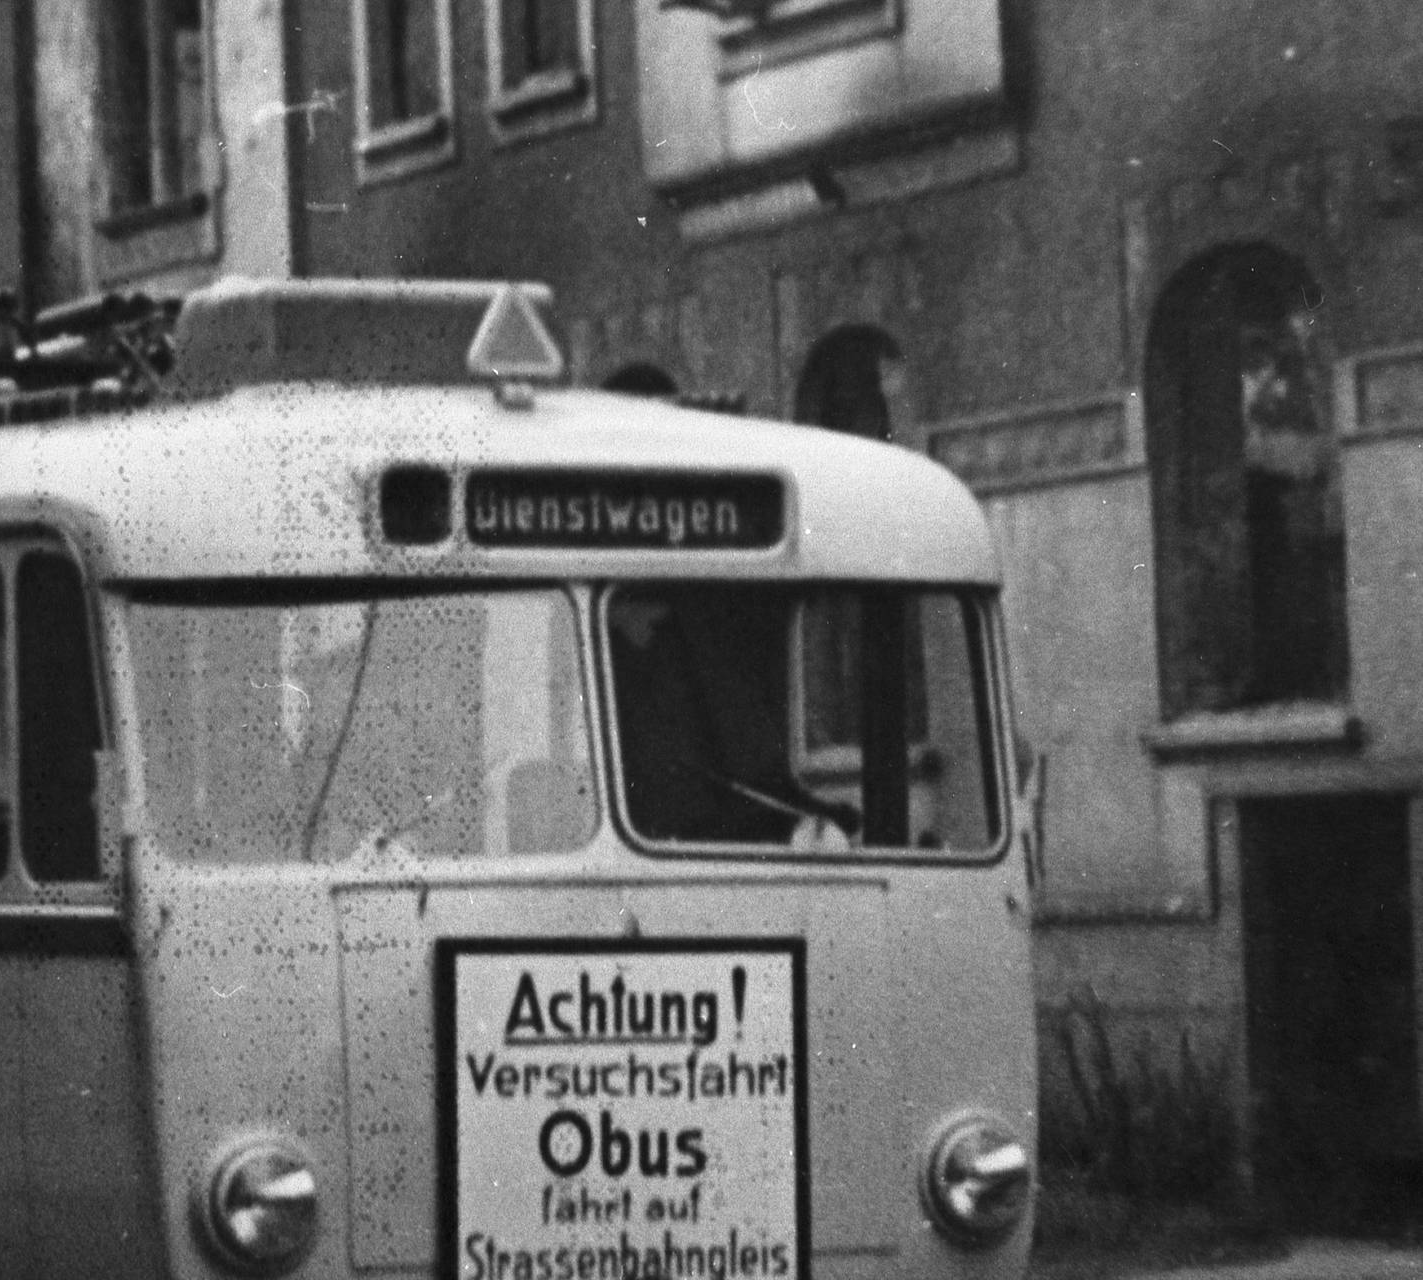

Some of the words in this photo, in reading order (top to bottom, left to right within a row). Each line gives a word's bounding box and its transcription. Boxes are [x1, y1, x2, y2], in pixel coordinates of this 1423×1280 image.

[466, 1050, 788, 1100] Versuchsfahrt
[539, 1109, 708, 1177] Obus
[645, 1184, 700, 1223] auf
[465, 1227, 789, 1280] Strassenbahngleis
